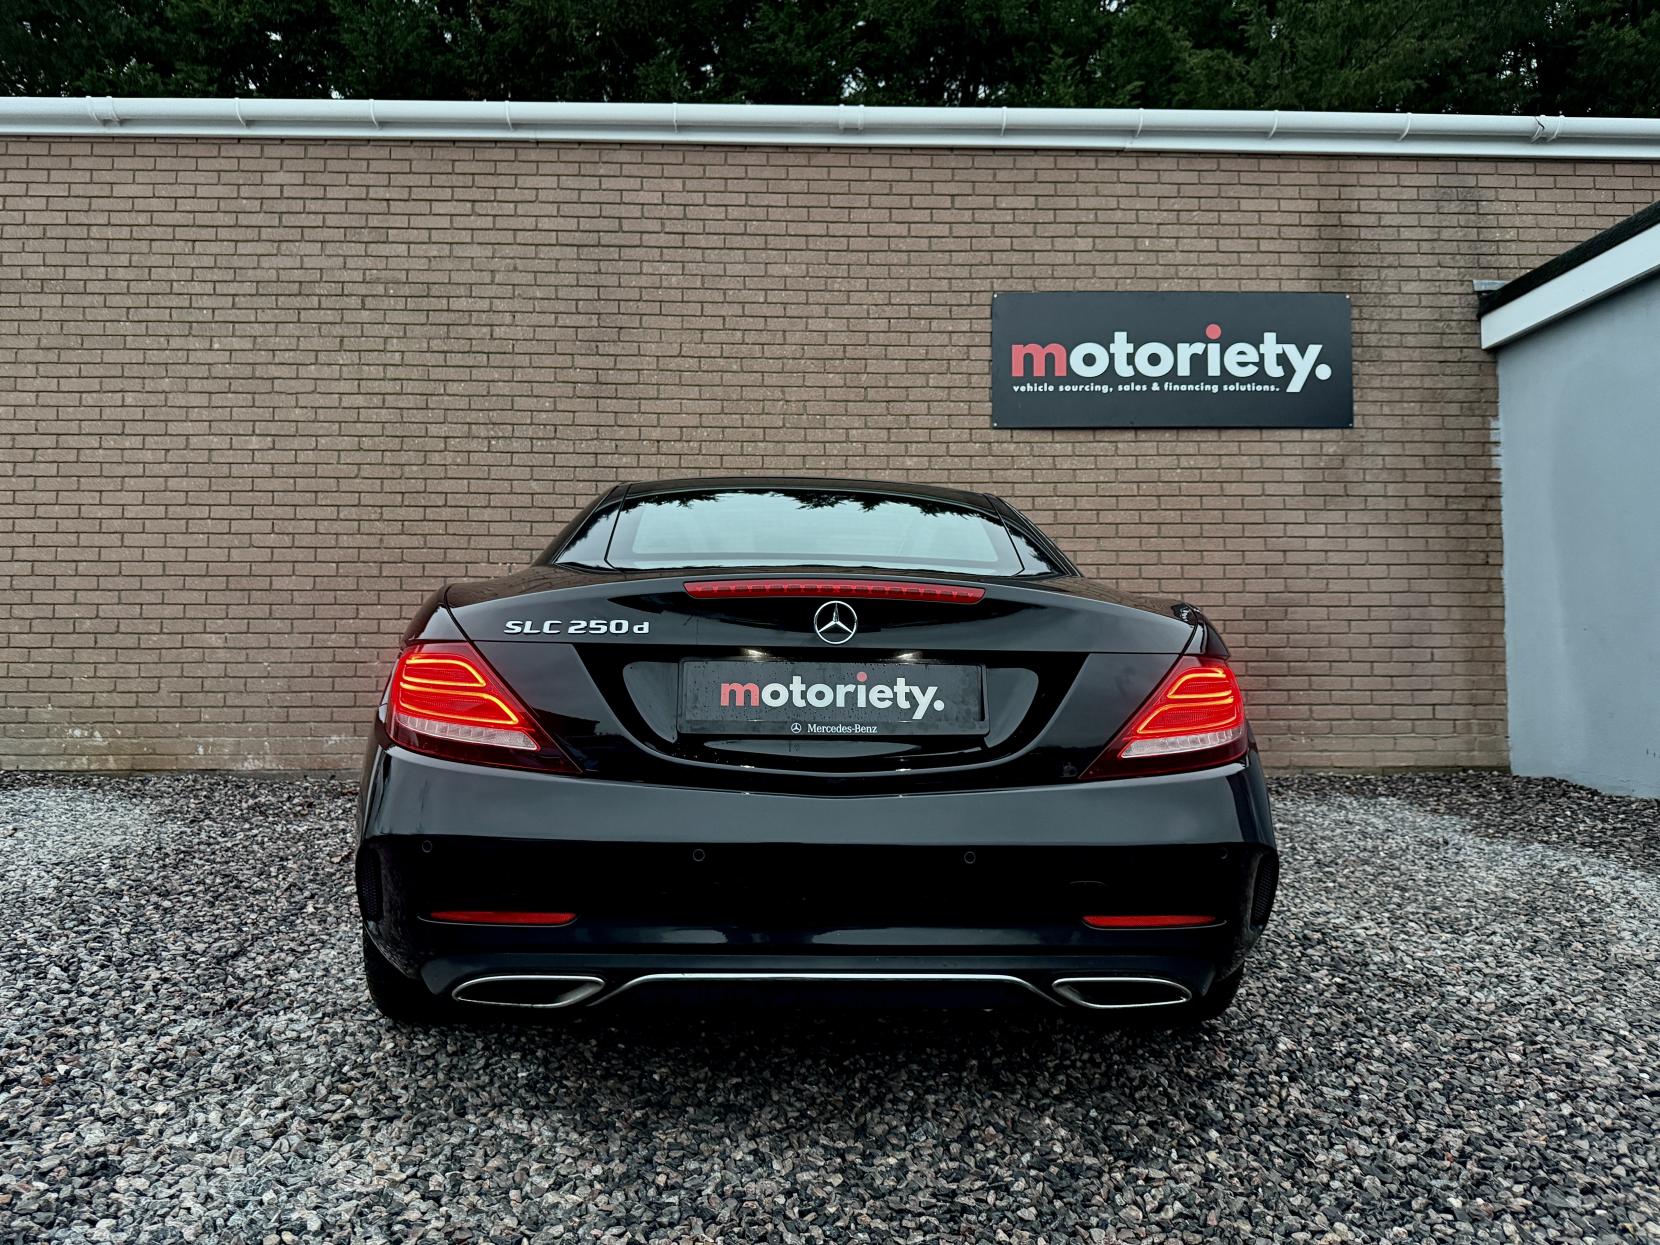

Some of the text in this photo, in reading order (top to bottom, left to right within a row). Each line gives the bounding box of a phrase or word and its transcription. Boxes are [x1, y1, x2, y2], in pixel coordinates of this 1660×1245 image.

[1011, 323, 1332, 393] motoriety.
[1013, 382, 1280, 394] vehicle sourcing, sales & financing solutions.
[503, 620, 563, 634] SLC
[720, 671, 945, 720] motoriety.
[807, 723, 878, 734] Mercedes-Benz
